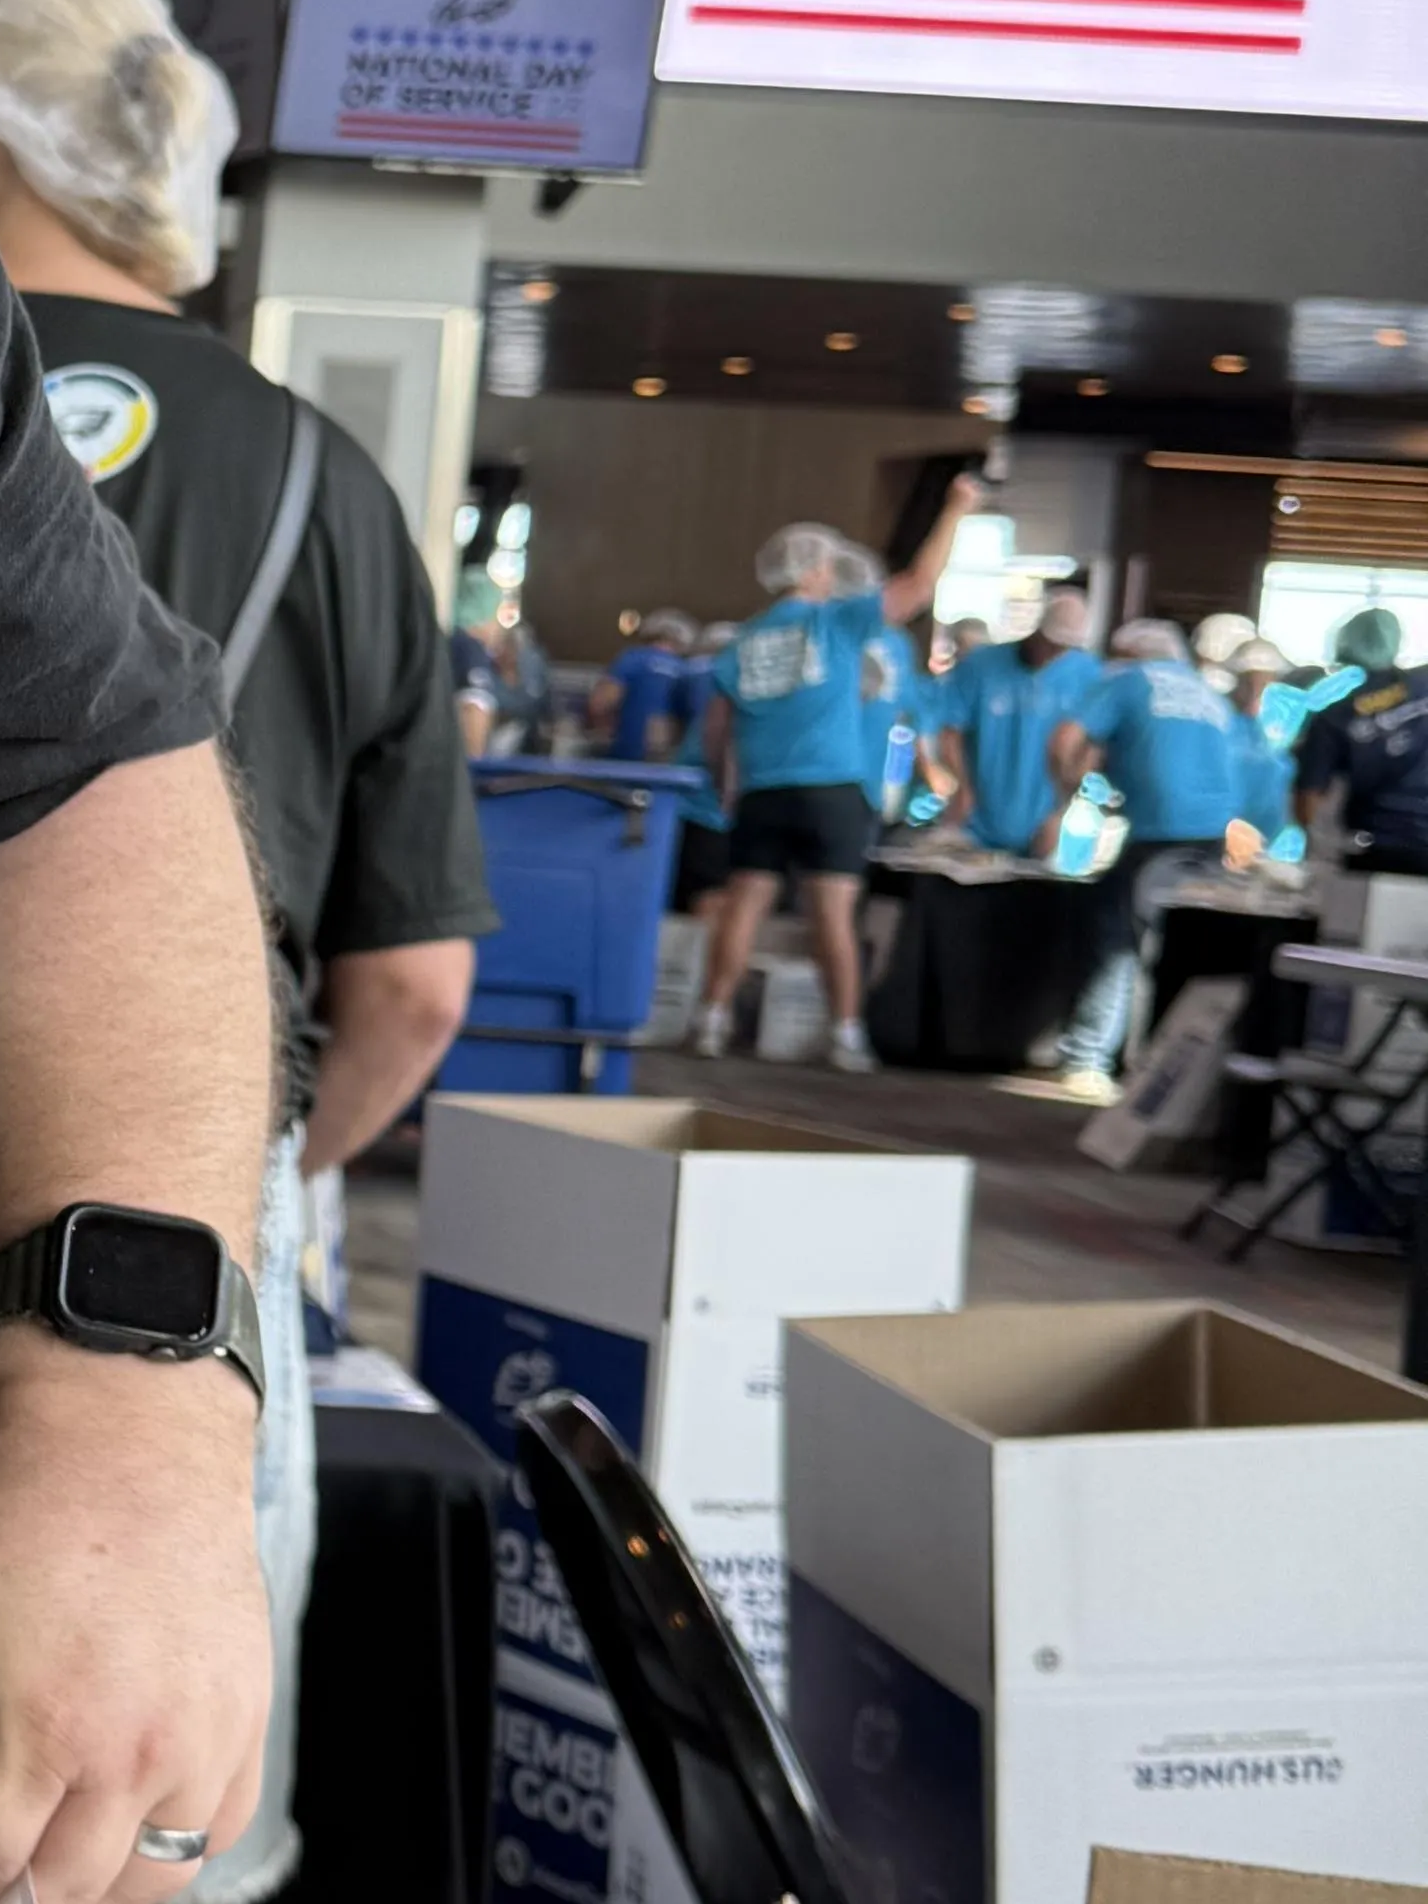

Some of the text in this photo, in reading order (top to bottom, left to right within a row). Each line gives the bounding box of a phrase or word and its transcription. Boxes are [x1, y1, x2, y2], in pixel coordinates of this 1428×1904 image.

[346, 53, 593, 90] NATIONAL DAY
[342, 83, 387, 110] OF
[397, 87, 533, 118] SERVICE
